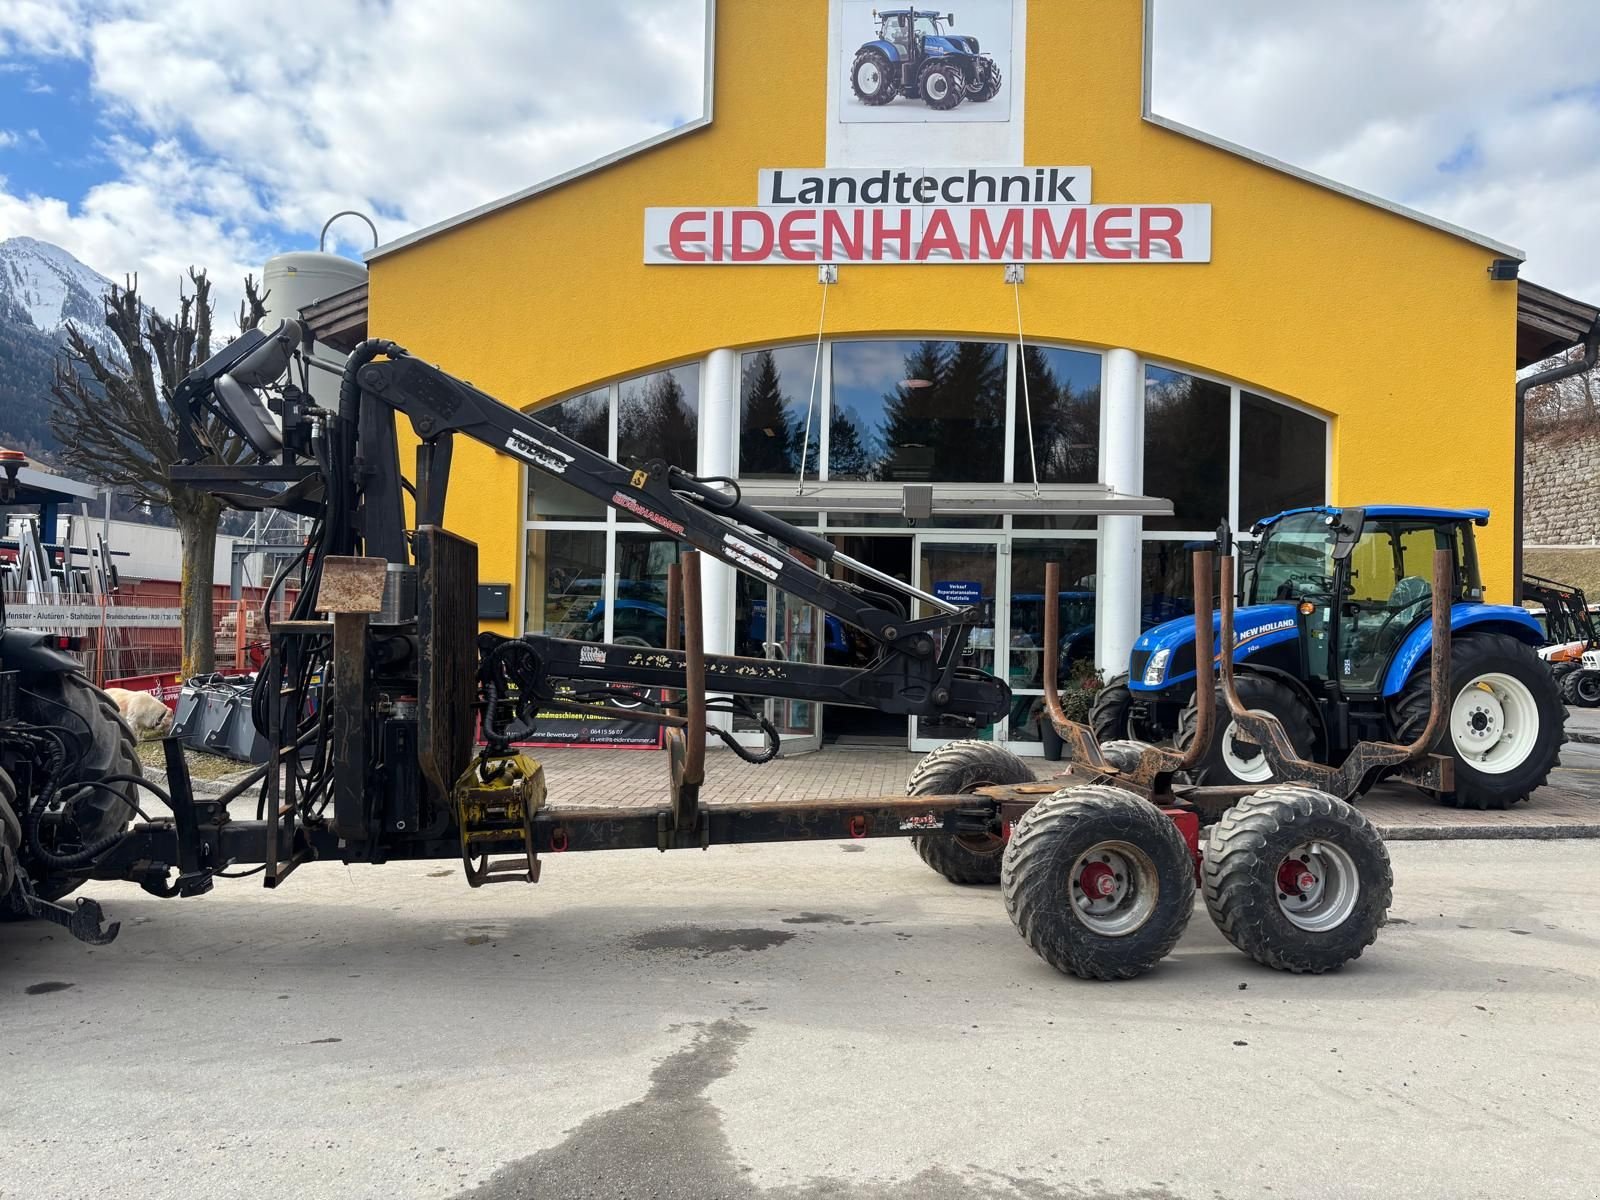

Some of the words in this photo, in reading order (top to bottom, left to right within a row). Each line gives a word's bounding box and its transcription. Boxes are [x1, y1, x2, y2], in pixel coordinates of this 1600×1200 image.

[771, 168, 1076, 204] Landtechnik
[669, 207, 1184, 262] EIDENHAMMER
[37, 612, 65, 620] Alutüren
[1240, 626, 1258, 640] NEW
[1260, 618, 1294, 632] HOLLAND
